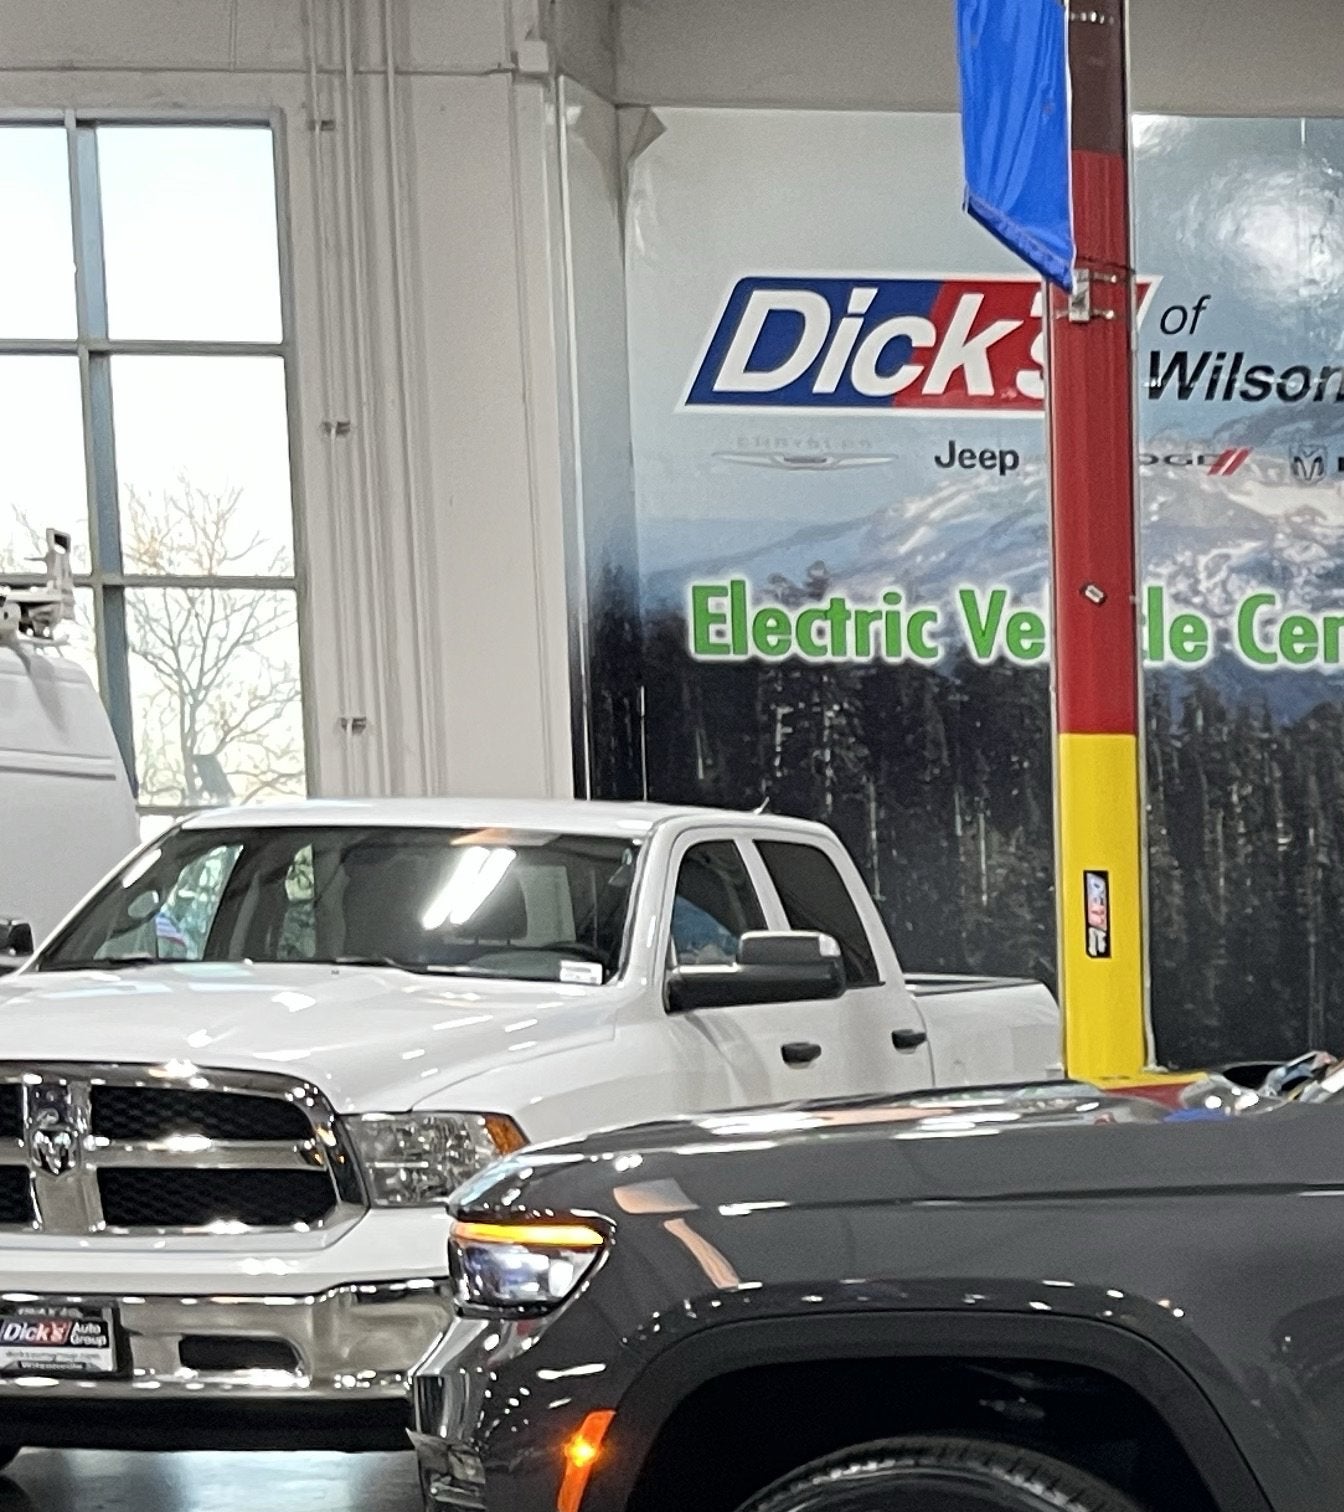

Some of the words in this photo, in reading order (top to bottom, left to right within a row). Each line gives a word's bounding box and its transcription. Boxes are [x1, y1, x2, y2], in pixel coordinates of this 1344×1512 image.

[1160, 294, 1211, 336] of
[934, 440, 1020, 476] Jeep
[691, 579, 938, 658] Electric
[959, 586, 1209, 663] Vele
[70, 1334, 107, 1348] Group
[71, 1321, 102, 1334] Auto
